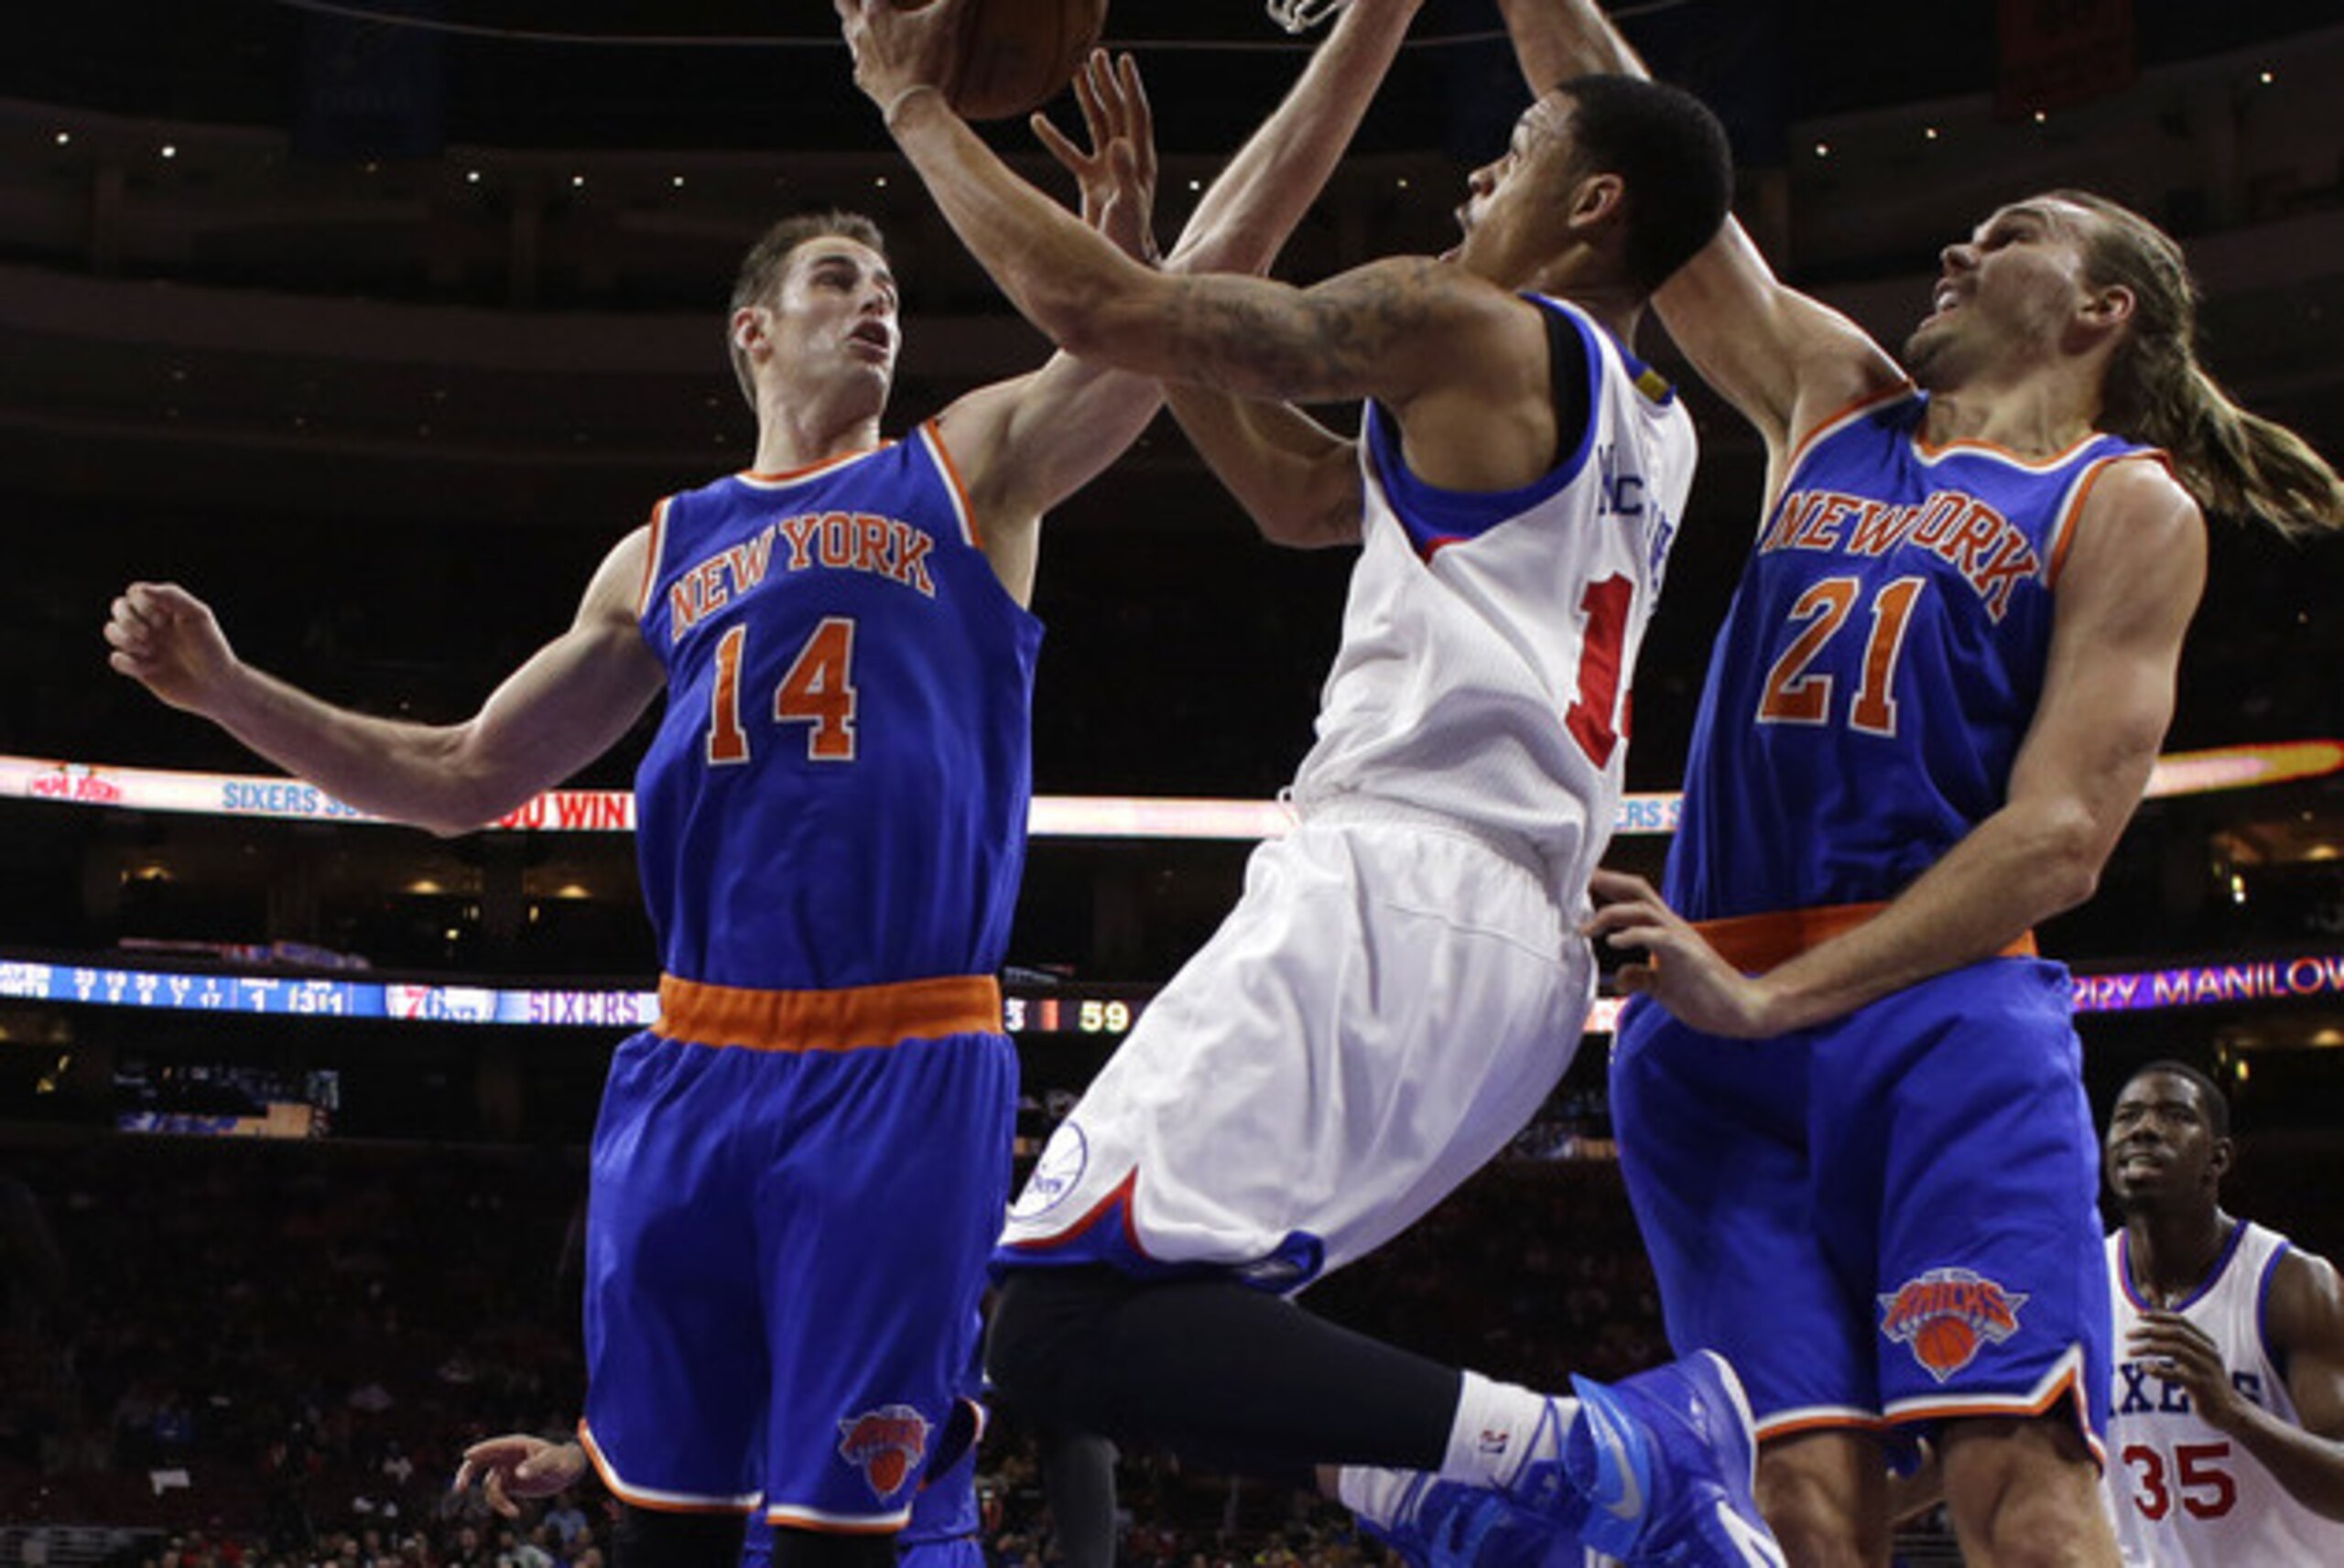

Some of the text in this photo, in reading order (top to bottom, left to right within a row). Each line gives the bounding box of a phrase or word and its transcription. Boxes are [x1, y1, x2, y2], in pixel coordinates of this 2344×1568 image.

[668, 511, 936, 643] NEW YORK
[1759, 491, 1921, 557] NEW
[1906, 489, 2040, 624] ORK
[707, 617, 857, 765] 14
[1565, 570, 1633, 771] 1
[1755, 575, 1926, 737] 21
[222, 781, 319, 813] SIXERS
[555, 793, 626, 828] WIN
[529, 992, 639, 1023] SIXERS
[1080, 1000, 1131, 1033] 59
[2122, 1441, 2237, 1521] 35
